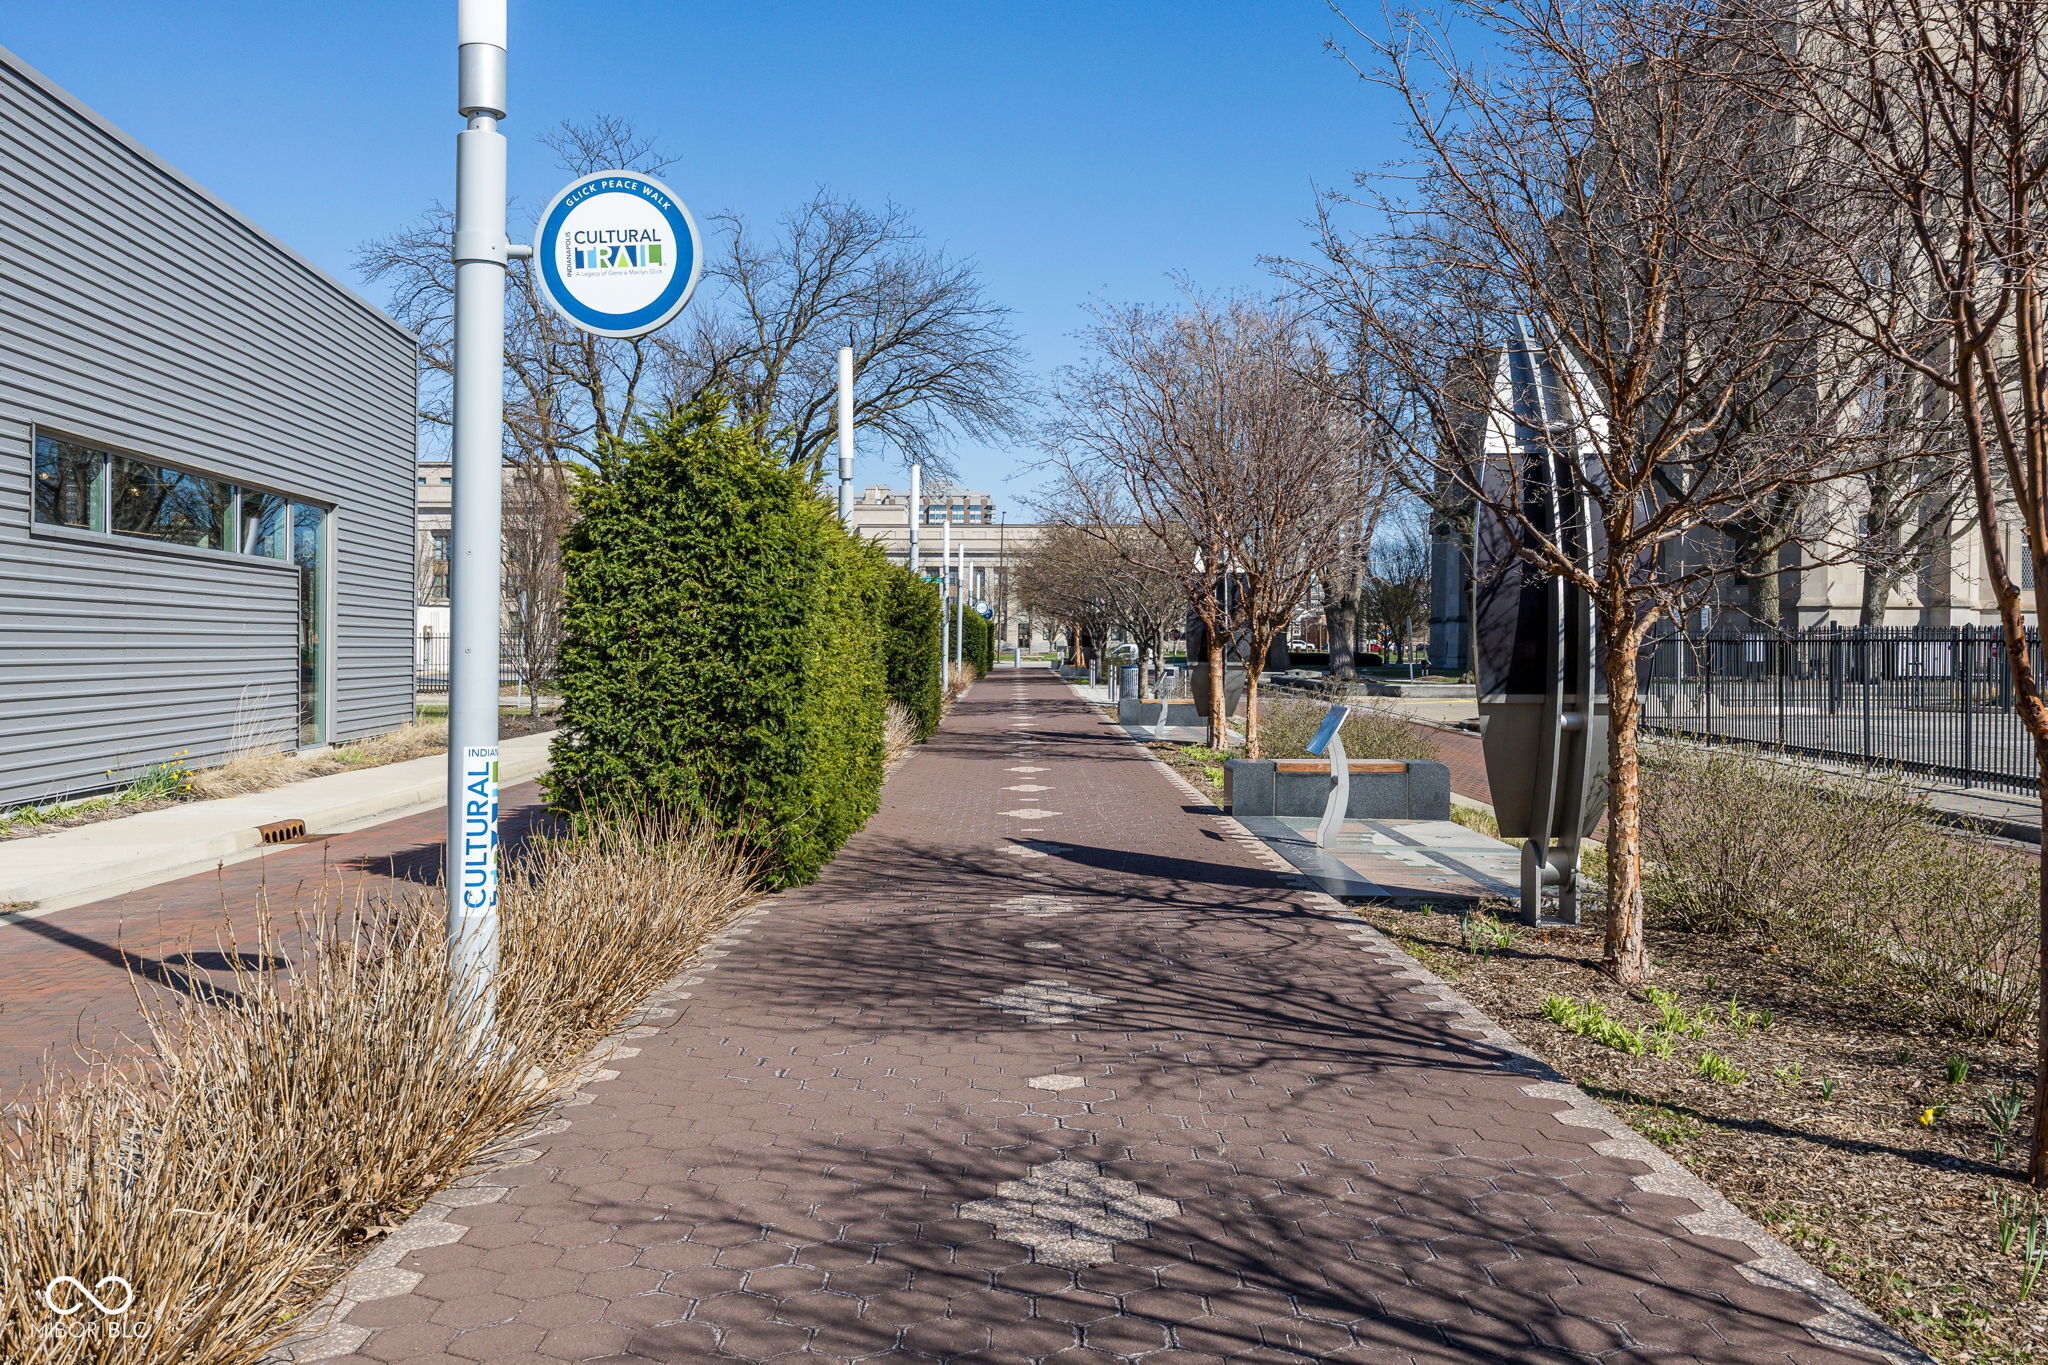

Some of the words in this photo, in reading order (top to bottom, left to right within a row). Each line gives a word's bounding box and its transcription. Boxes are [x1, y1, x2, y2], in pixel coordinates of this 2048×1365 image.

[565, 183, 597, 207] GLICK
[601, 180, 638, 191] PEACE
[642, 185, 671, 210] WALK
[574, 228, 662, 244] CULTURAL
[565, 231, 573, 278] INDIANAPOLIS
[575, 244, 663, 269] TRAIL
[464, 761, 489, 909] CULTURAL
